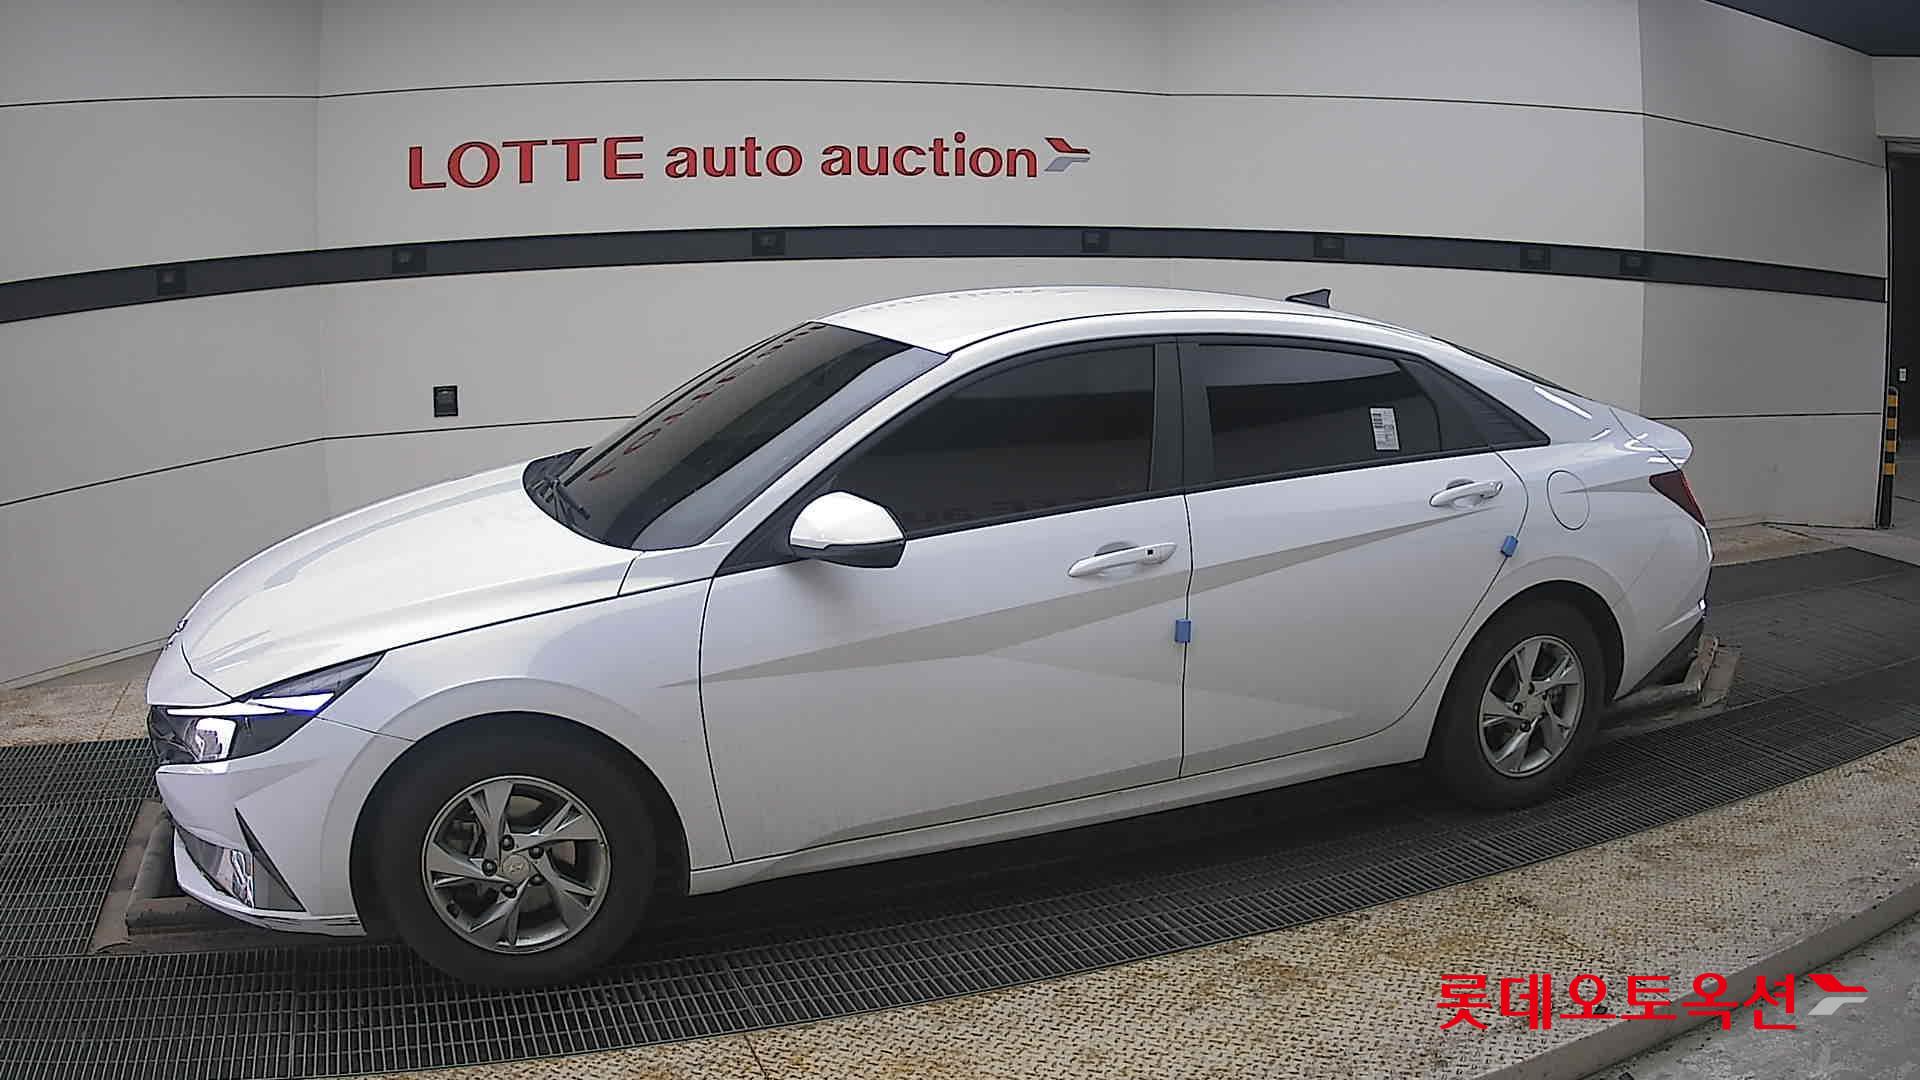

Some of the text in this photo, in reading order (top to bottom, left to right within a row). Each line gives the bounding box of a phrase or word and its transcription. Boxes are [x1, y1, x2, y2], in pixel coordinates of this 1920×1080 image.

[408, 131, 1038, 190] LOTTE auto auction
